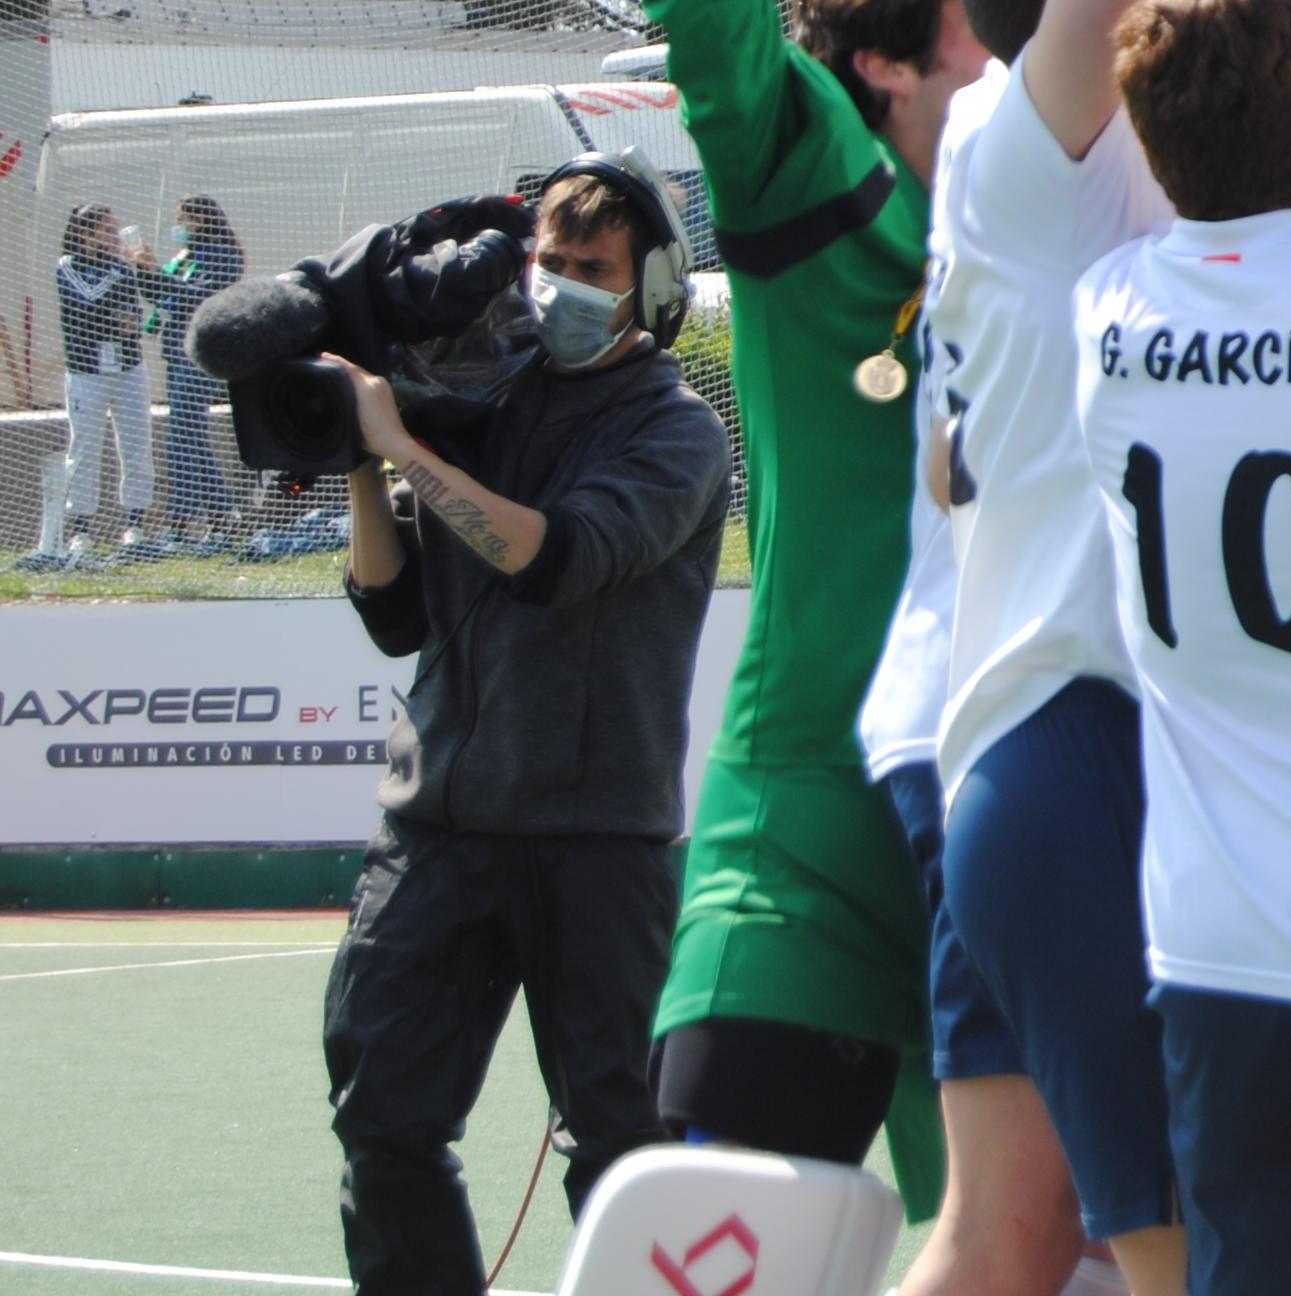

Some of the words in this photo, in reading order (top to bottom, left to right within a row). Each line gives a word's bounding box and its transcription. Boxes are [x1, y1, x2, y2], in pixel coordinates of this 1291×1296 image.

[1100, 320, 1129, 379] G.
[0, 686, 281, 726] AXPEED
[299, 706, 338, 722] BY
[60, 741, 253, 763] ILUMINACIÓN
[276, 745, 322, 761] LED
[346, 744, 389, 760] DE
